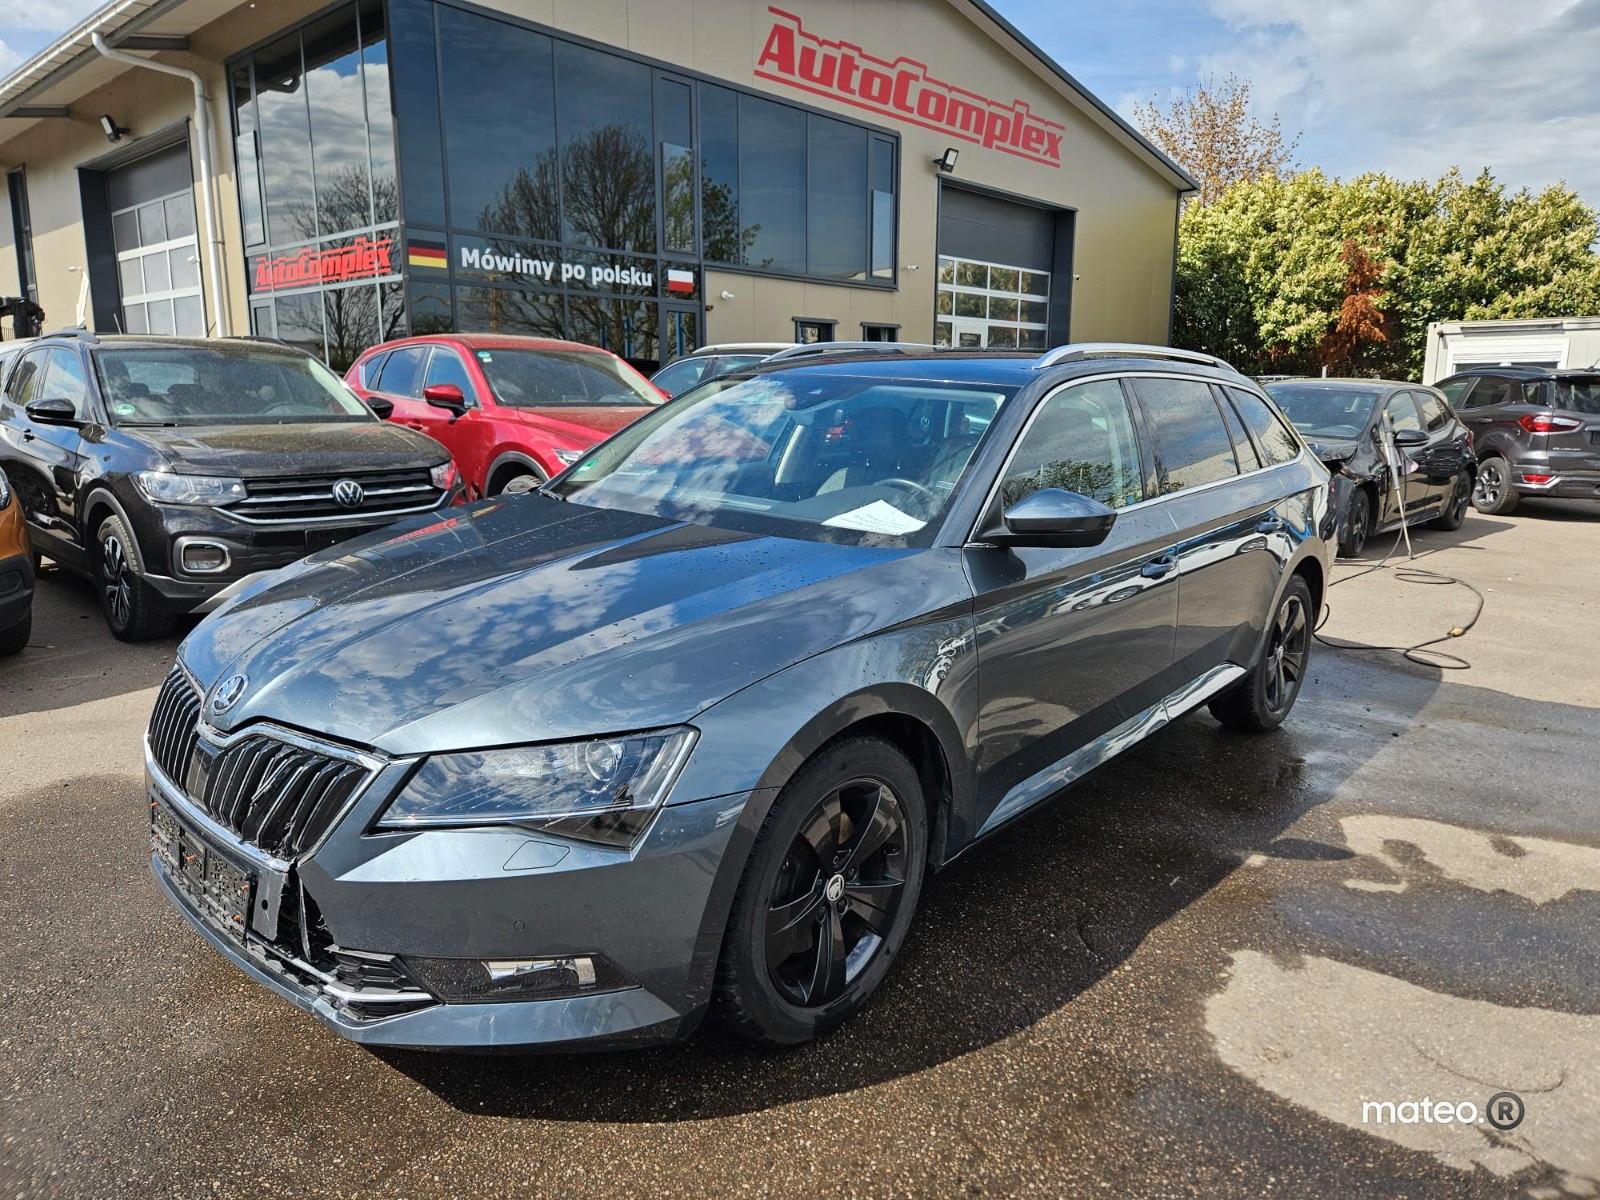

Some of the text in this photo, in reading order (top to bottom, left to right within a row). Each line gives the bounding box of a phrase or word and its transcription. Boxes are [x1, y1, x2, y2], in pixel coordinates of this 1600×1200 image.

[758, 23, 1063, 161] AutoComplex
[255, 246, 391, 286] AutoComplex
[460, 247, 653, 287] Mówimy po polsku
